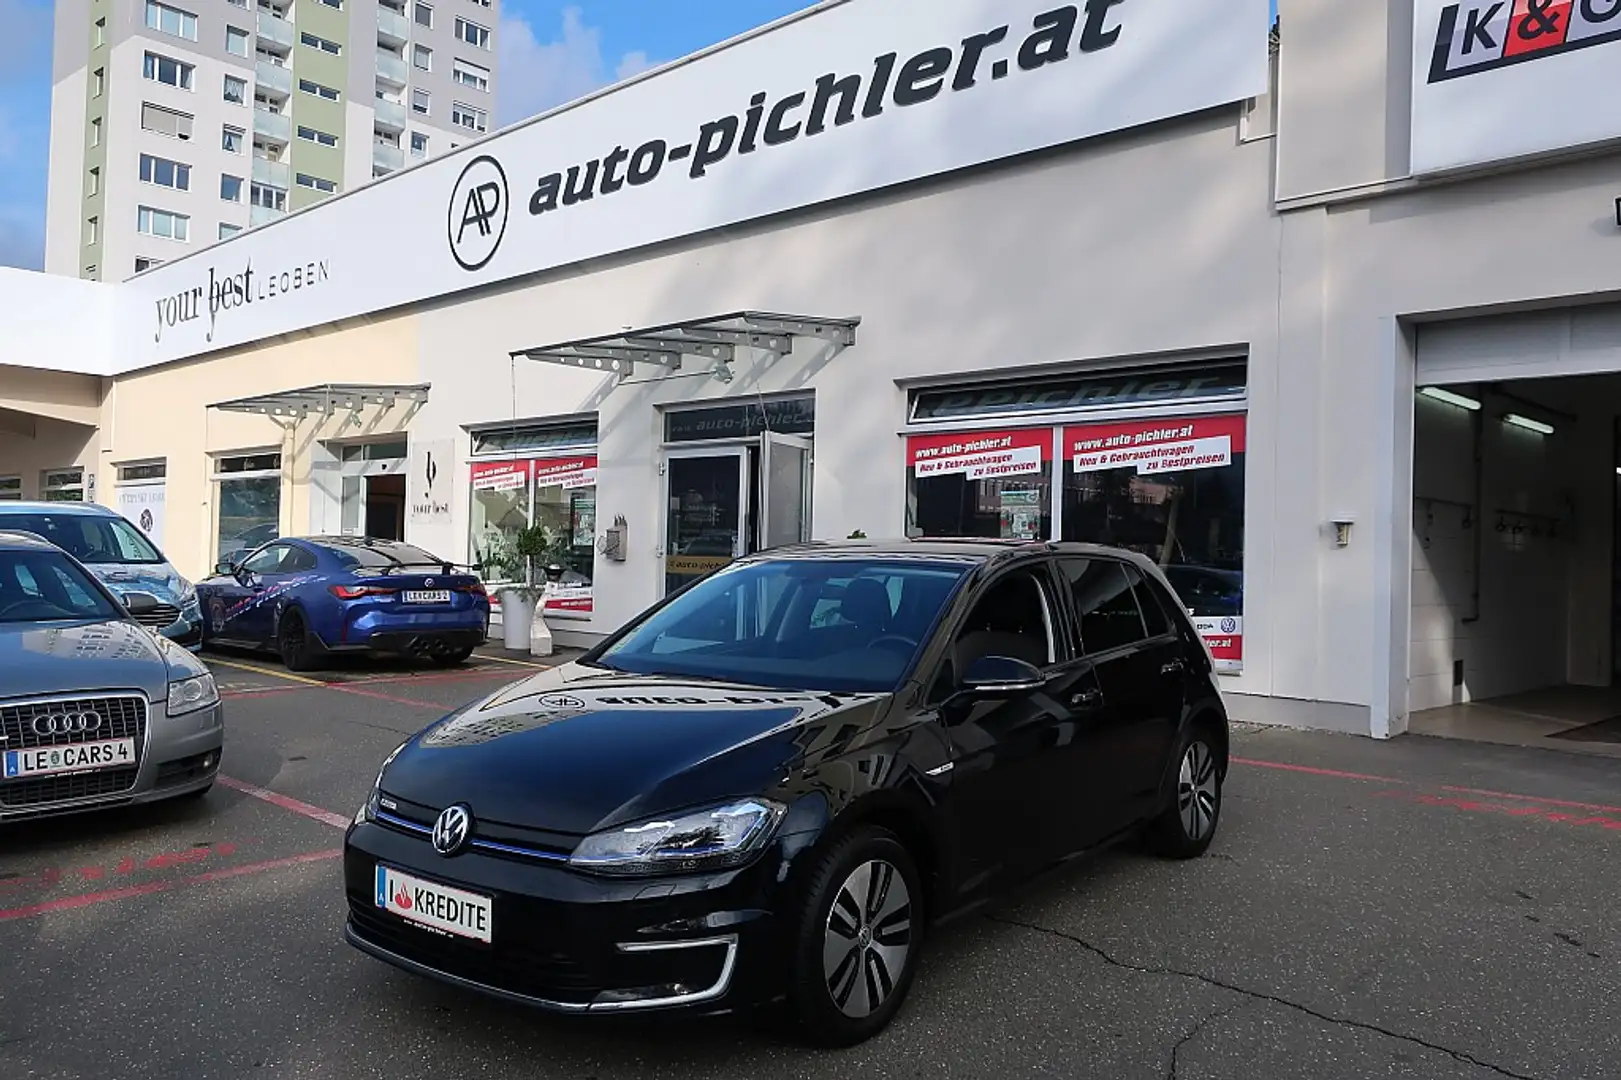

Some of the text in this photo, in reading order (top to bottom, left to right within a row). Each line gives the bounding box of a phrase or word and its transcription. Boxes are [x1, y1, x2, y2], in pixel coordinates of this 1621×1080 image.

[528, 0, 1124, 217] auto-pichler.at
[155, 256, 330, 343] your best LEOBEN
[915, 435, 1012, 459] www.auto-pichler.at
[1074, 424, 1193, 451] www.auto-pichler.at
[1109, 444, 1195, 465] Gebrauchtwagen
[1161, 452, 1225, 470] Bestpreisen
[23, 742, 128, 771] LE CARS 4
[414, 887, 486, 932] KREDITE
